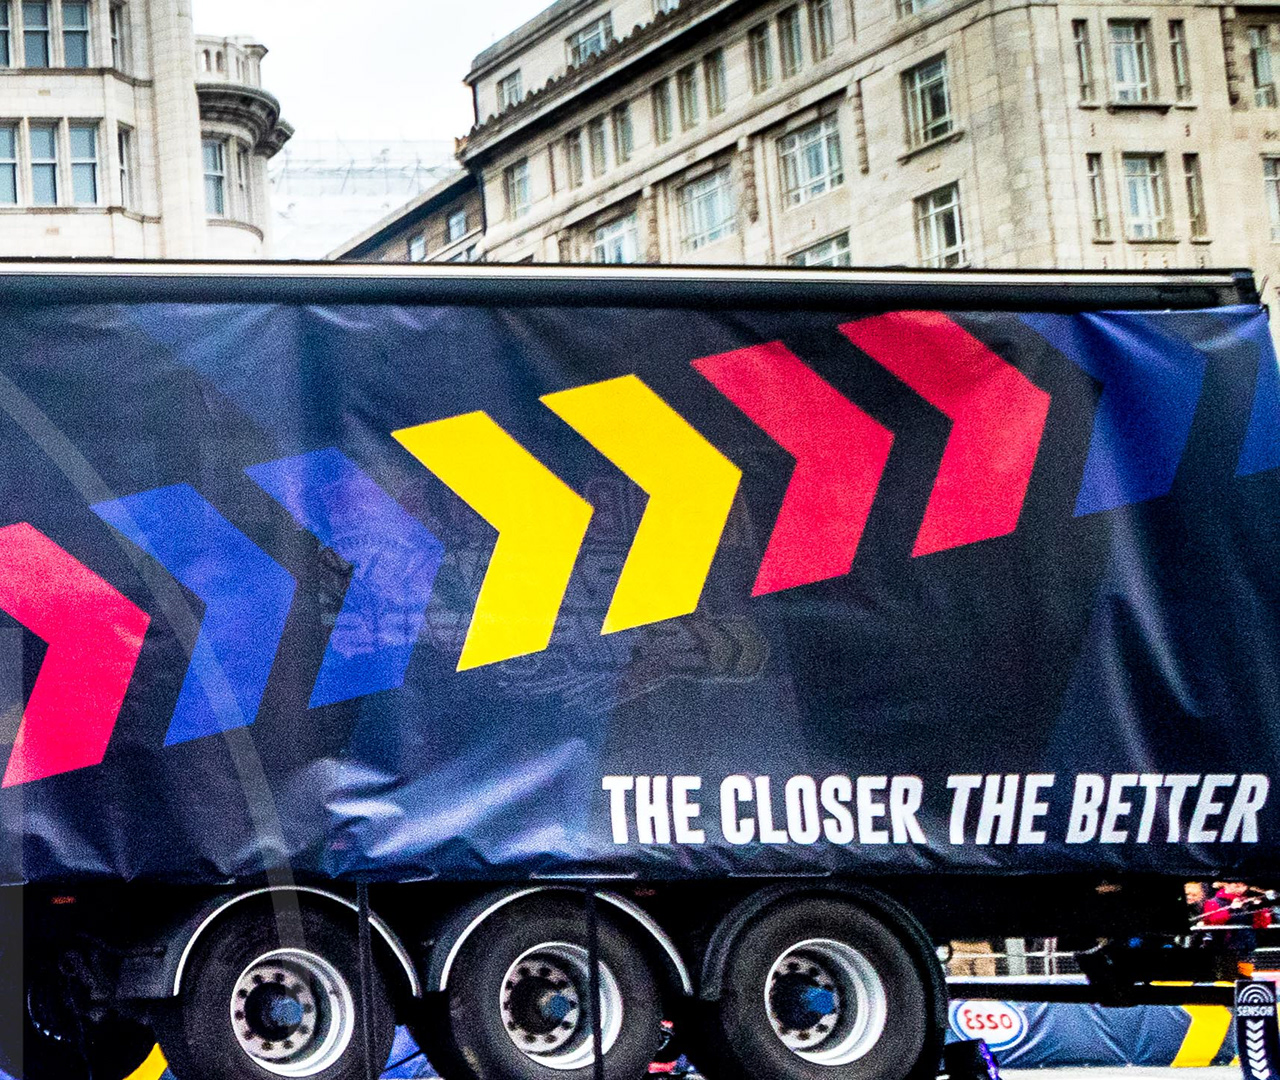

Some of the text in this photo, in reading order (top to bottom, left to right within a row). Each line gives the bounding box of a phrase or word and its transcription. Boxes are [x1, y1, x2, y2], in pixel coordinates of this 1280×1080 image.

[601, 773, 1271, 846] THE CLOSER THE BETTER
[1236, 1004, 1274, 1017] SENSOR
